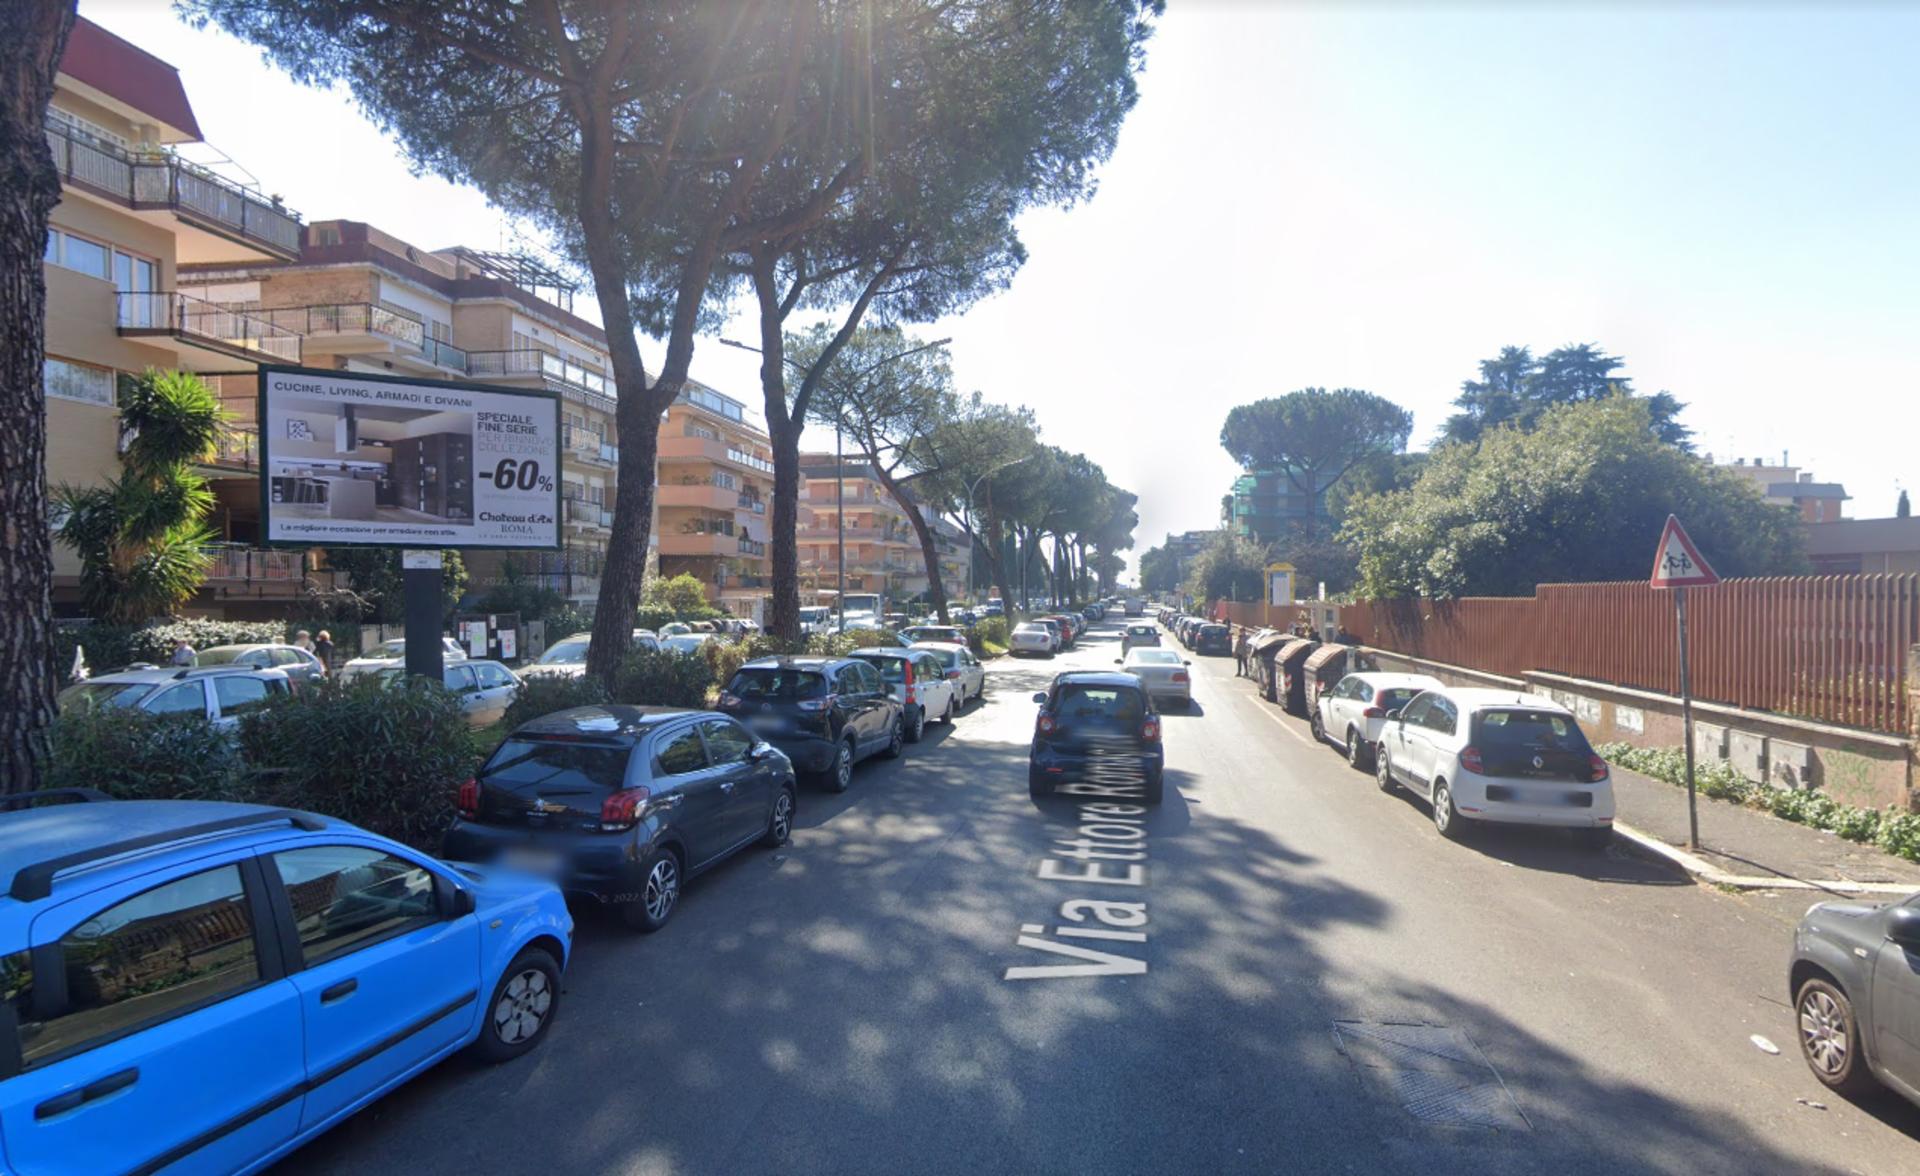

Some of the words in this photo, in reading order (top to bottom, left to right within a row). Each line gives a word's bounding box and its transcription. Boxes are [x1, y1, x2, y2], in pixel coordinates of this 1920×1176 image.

[274, 382, 326, 396] CUCINE,
[329, 386, 373, 399] LIVING,
[375, 391, 421, 403] ARMADI
[424, 395, 433, 405] E
[435, 396, 473, 408] DIVANI
[477, 412, 533, 425] SPECIALE
[477, 422, 504, 434] FINE
[506, 424, 538, 436] SERIE
[478, 458, 553, 492] -60%
[479, 512, 526, 523] Chateau
[501, 524, 533, 534] ROMA
